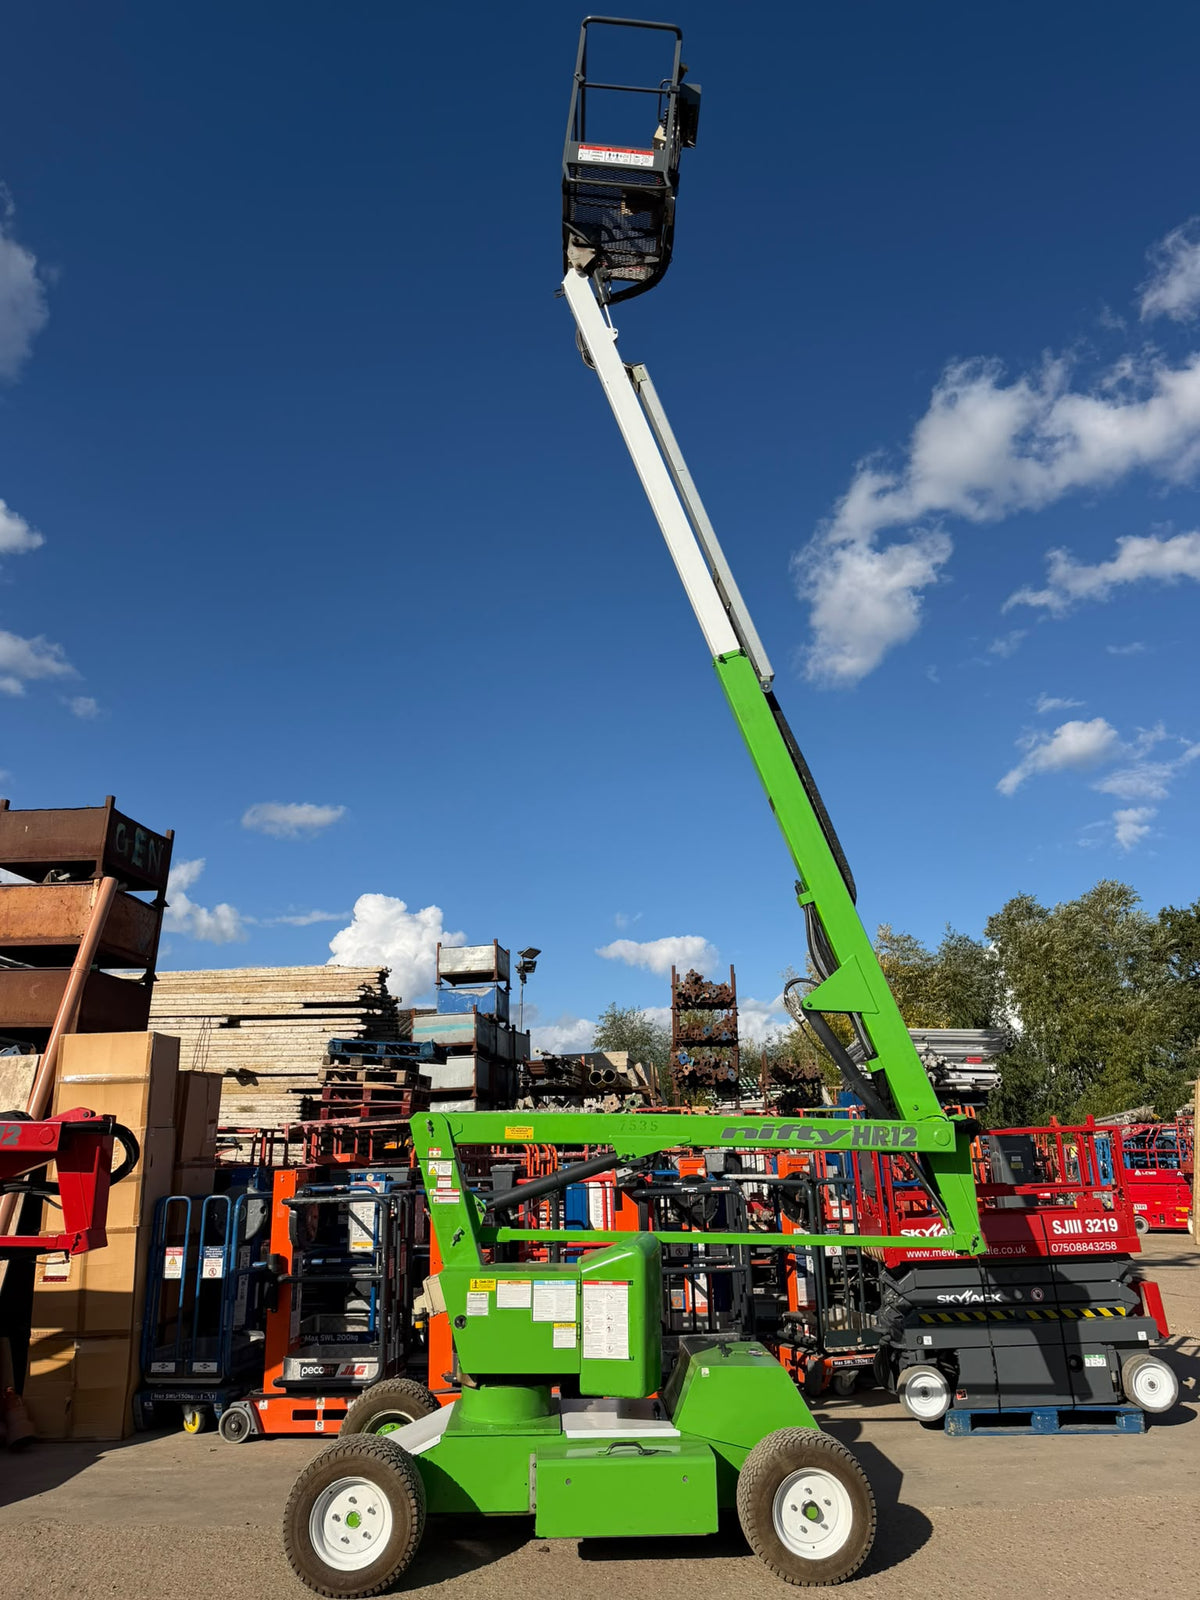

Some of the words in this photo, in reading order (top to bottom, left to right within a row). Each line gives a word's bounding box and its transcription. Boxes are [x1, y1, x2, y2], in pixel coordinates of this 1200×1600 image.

[619, 1119, 659, 1132] 7535
[721, 1122, 851, 1145] nifty
[851, 1125, 918, 1147] HR12
[1052, 1219, 1082, 1235] SJIII
[1085, 1217, 1118, 1233] 3219
[1051, 1241, 1117, 1253] 07508843258
[936, 1289, 1003, 1305] SKYJACK
[320, 1334, 335, 1342] SWL
[340, 1365, 367, 1376] JLG
